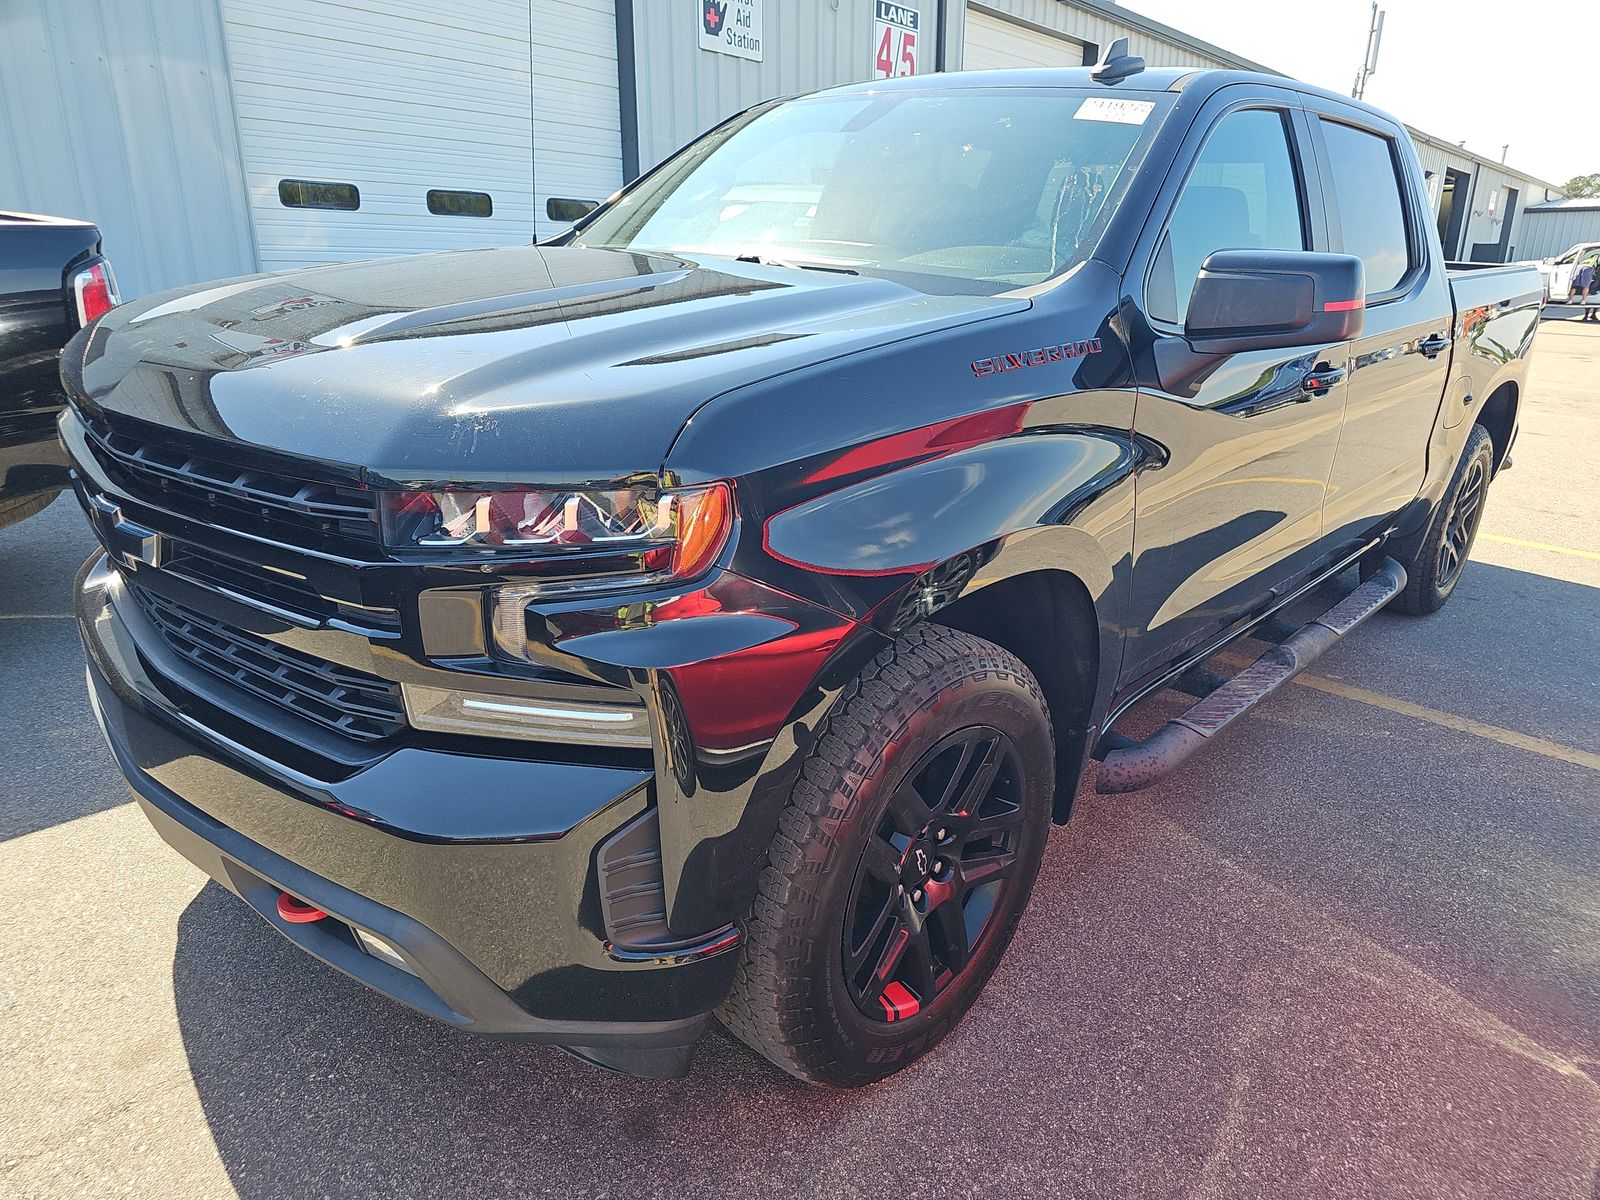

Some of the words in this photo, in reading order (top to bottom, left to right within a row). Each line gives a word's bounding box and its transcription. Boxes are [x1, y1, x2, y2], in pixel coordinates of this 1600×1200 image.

[736, 8, 751, 28] Aid
[881, 3, 915, 27] LANE
[726, 27, 760, 52] Station
[971, 338, 1103, 377] SILVERADO
